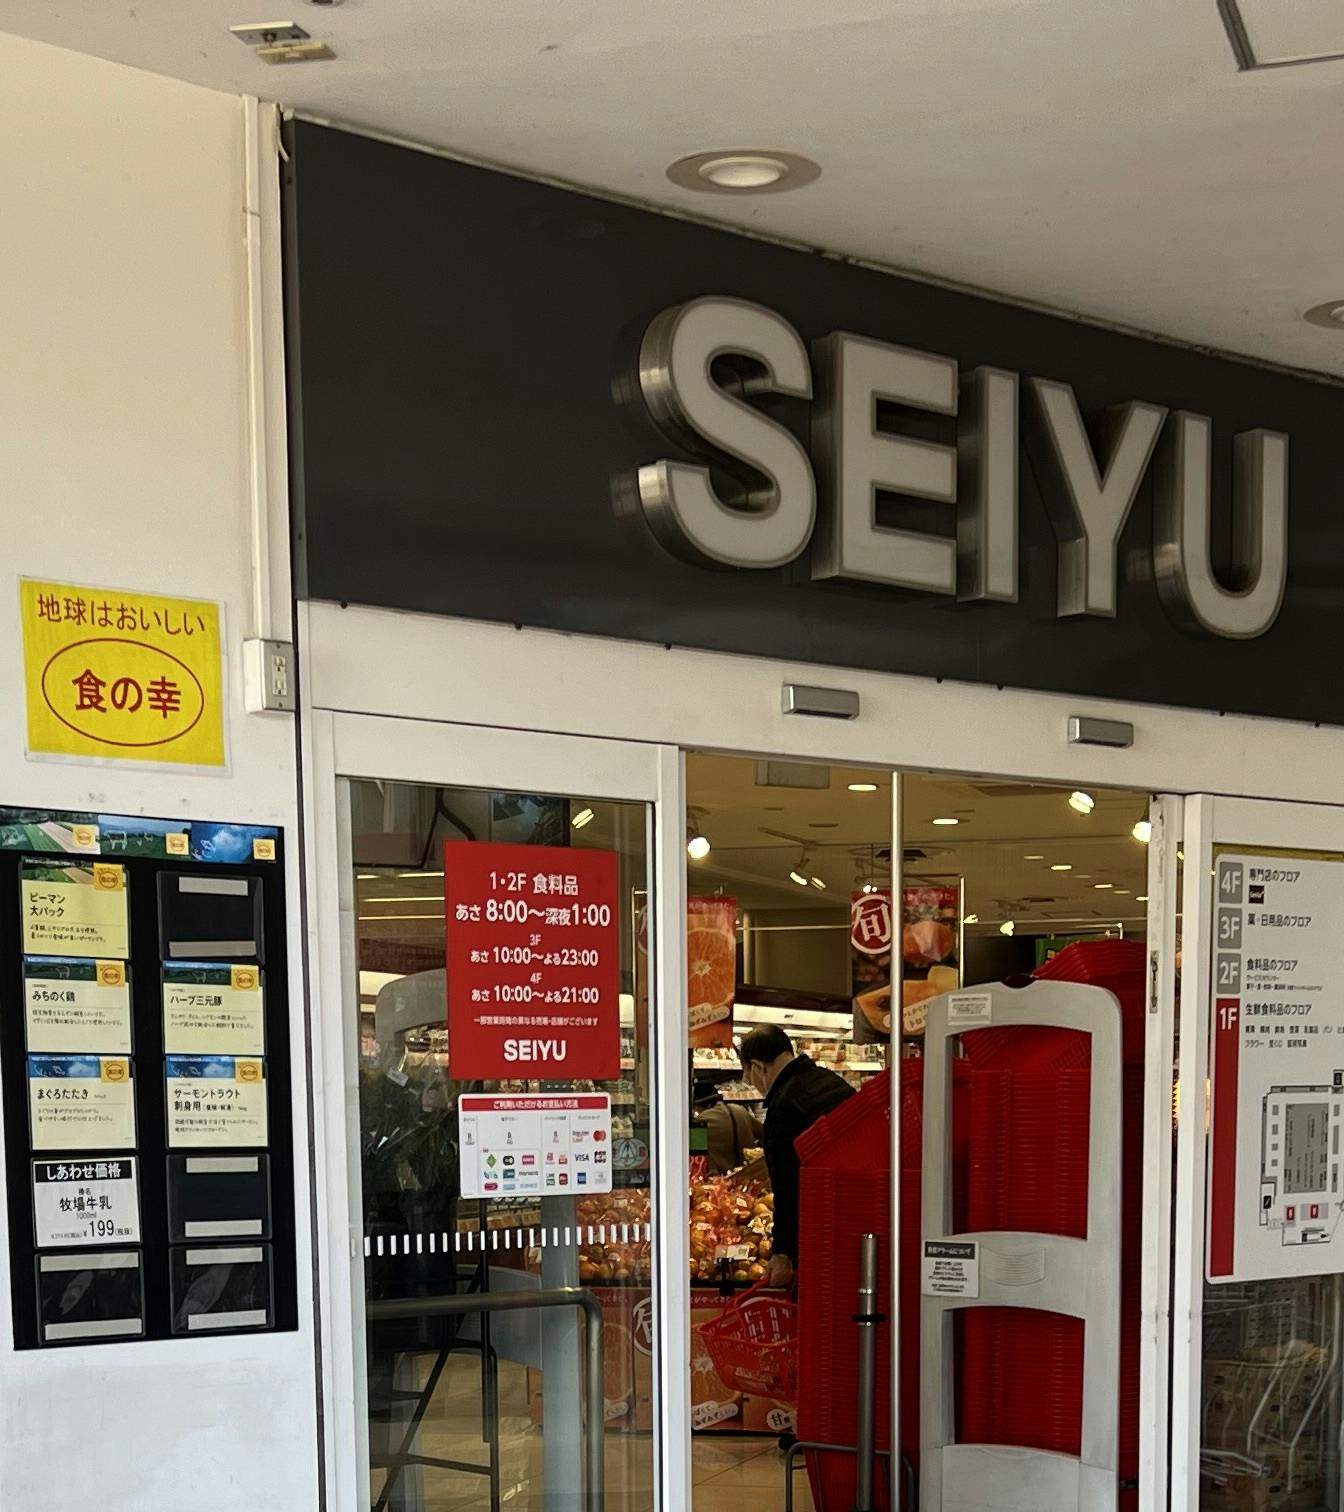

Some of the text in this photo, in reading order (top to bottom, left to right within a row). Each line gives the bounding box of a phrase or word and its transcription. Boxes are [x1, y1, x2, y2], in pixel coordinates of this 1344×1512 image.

[639, 294, 1289, 640] SEIYU
[37, 594, 205, 636] 地球はおいしい
[72, 668, 181, 719] 食の幸
[532, 873, 579, 896] 食料品
[1221, 871, 1241, 893] 4F
[456, 903, 482, 922] あさ
[1219, 916, 1240, 939] 3F
[529, 934, 542, 946] 3F
[470, 951, 489, 964] あさ
[530, 972, 542, 984] 4F
[1219, 961, 1239, 985] 2F
[471, 989, 490, 1002] あさ
[1220, 1007, 1238, 1030] 1F
[503, 1039, 567, 1062] SEIYU
[37, 1088, 89, 1100] まぐろたたき
[174, 1088, 241, 1099] サーモントラウト
[46, 1162, 122, 1180] しあわせ価格
[59, 1195, 112, 1212] 牧場牛乳
